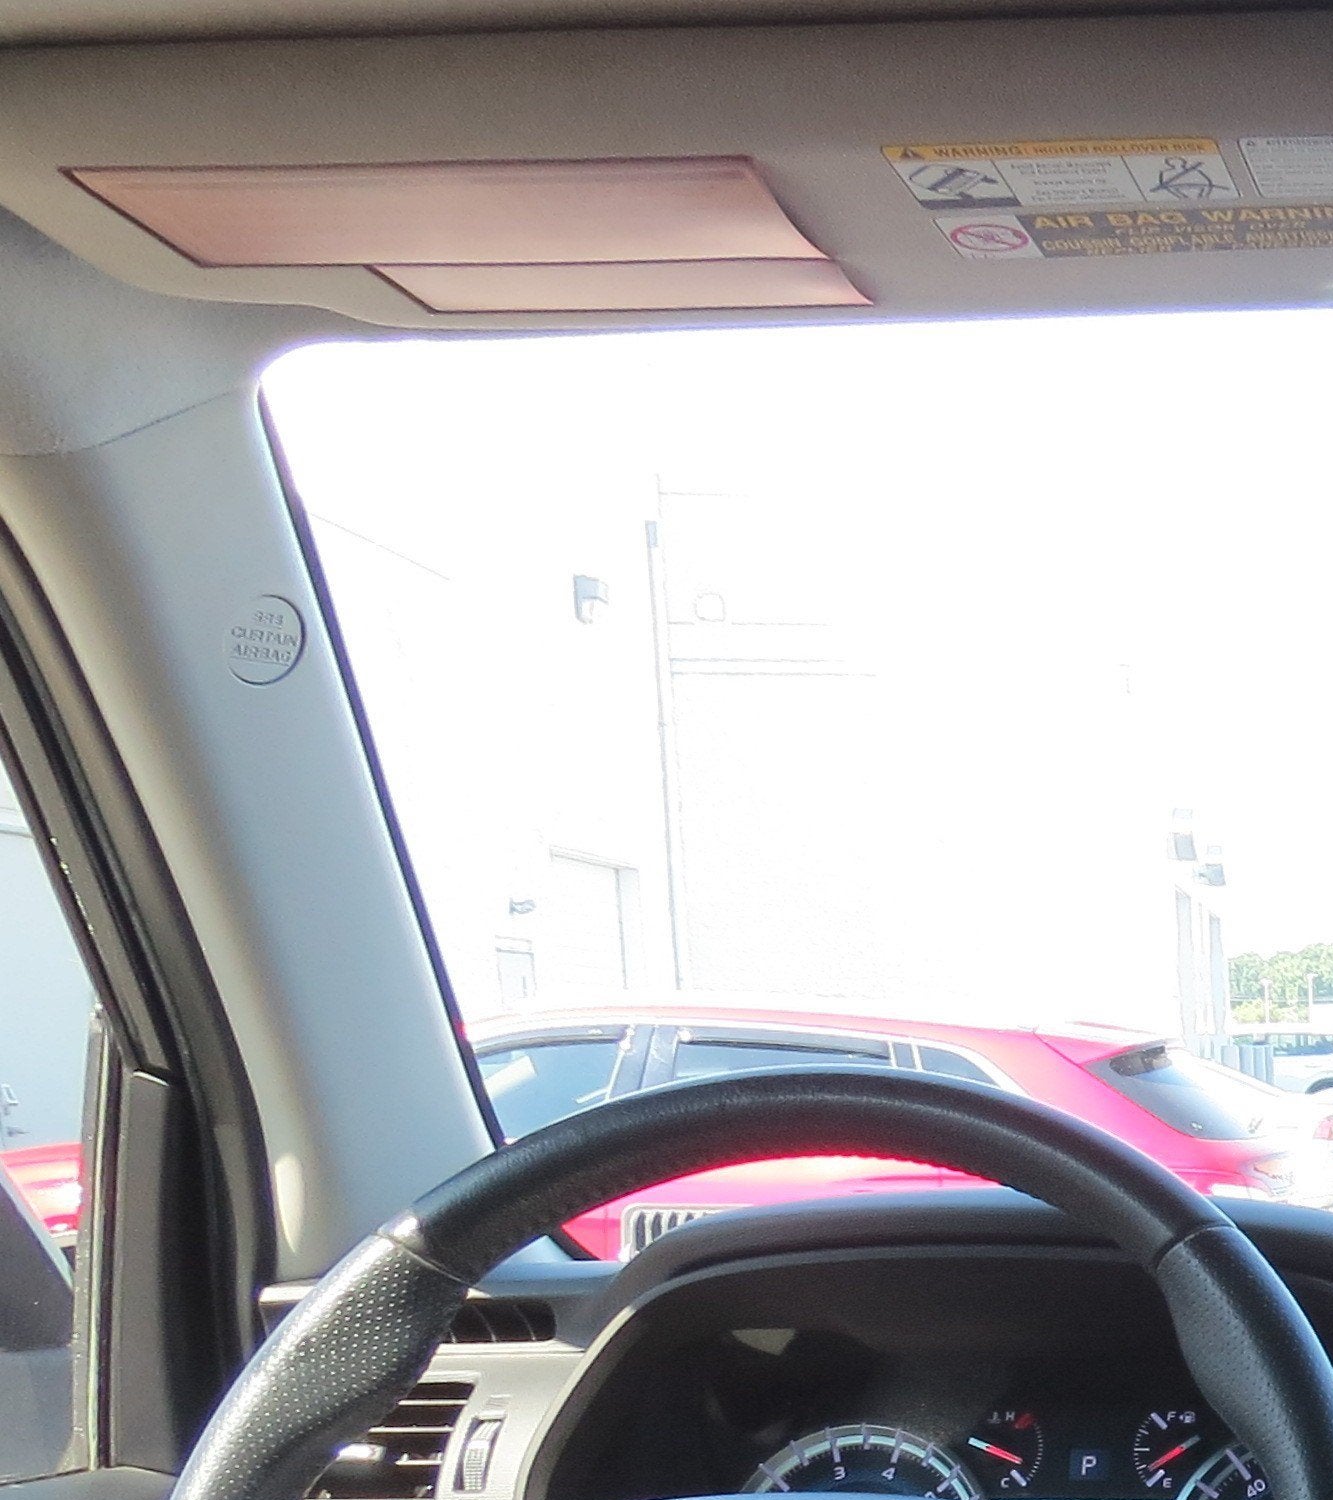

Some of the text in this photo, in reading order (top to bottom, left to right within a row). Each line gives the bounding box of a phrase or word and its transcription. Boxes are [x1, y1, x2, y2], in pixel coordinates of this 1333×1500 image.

[1034, 212, 1095, 229] AIR
[1106, 209, 1187, 227] BAG
[1166, 1411, 1177, 1422] F
[833, 1465, 847, 1481] 3
[1080, 1455, 1098, 1476] P
[880, 1466, 897, 1482] 4
[1000, 1477, 1010, 1489] C
[1162, 1477, 1173, 1489] E
[1246, 1478, 1267, 1499] 40
